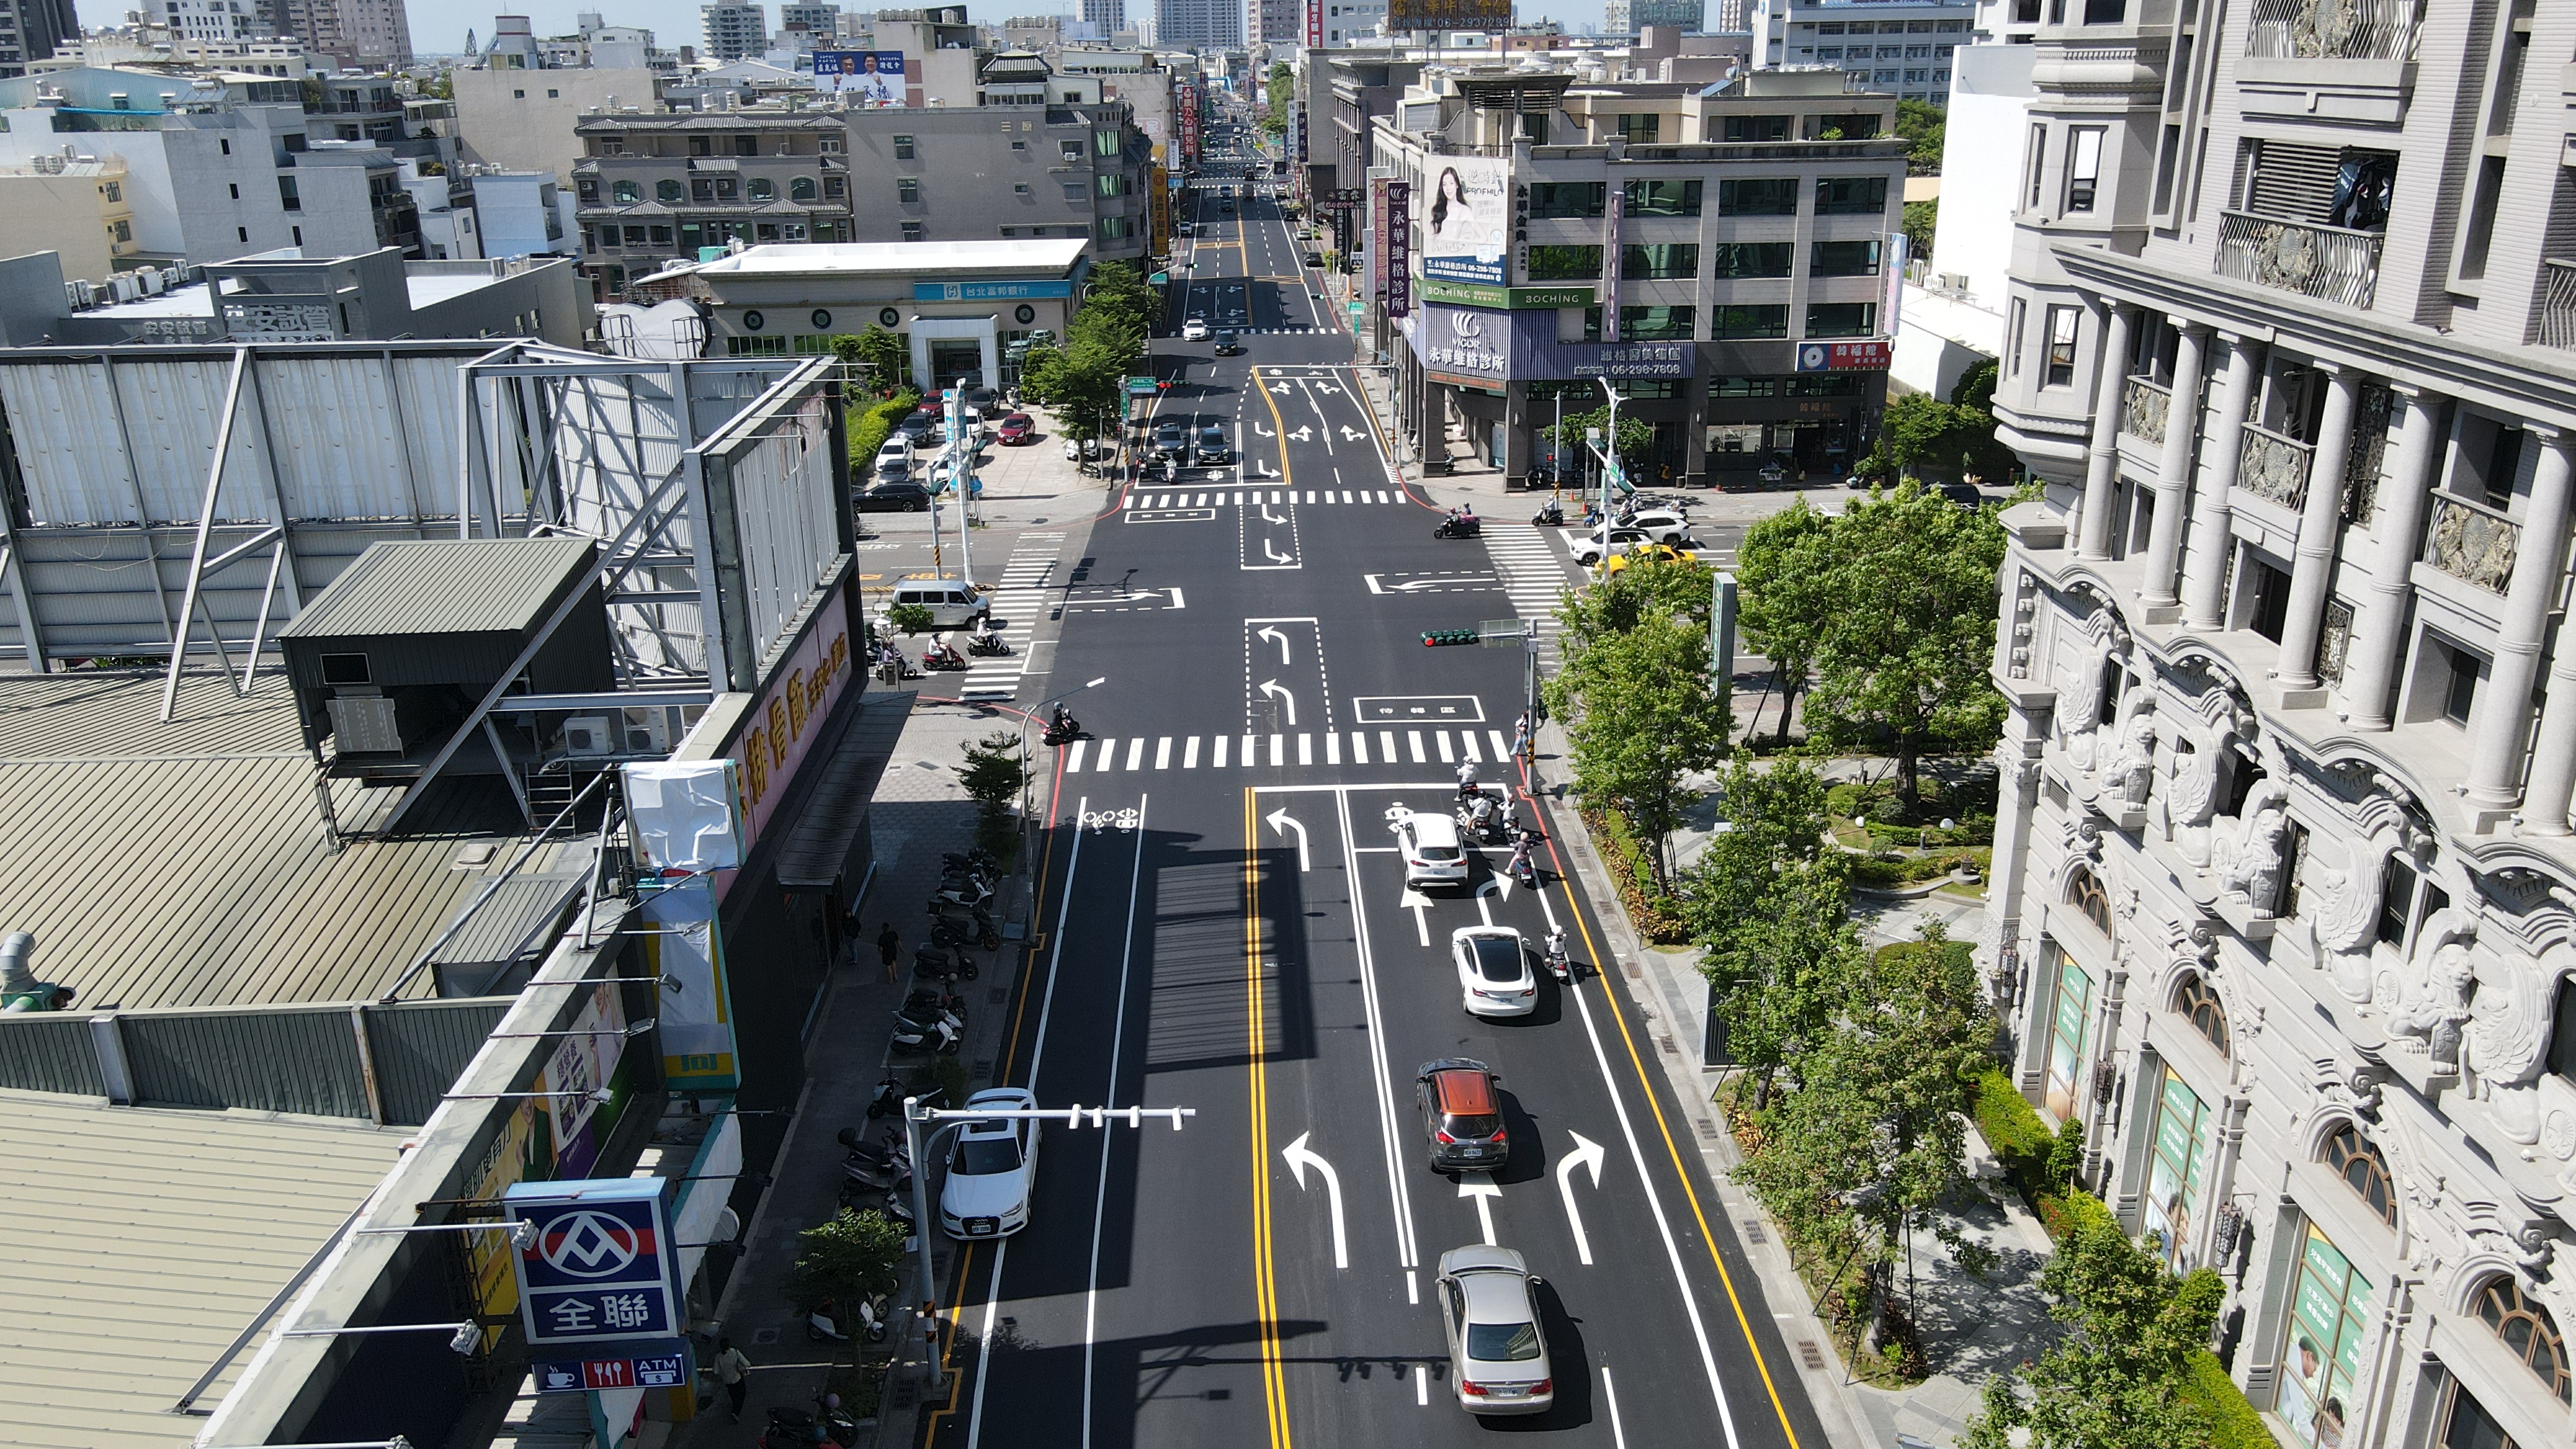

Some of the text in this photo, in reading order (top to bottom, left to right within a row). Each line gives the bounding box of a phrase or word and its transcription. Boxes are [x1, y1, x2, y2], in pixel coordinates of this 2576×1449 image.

[1390, 210, 1405, 311] 永華維格診所
[967, 286, 1028, 296] 台北富邦銀行
[1526, 293, 1579, 303] BOCHING
[223, 305, 331, 332] 安安試管
[144, 321, 207, 335] 安安試管
[1428, 346, 1505, 372] 永華維格診所
[1611, 364, 1680, 375] 06-298-7808
[549, 1293, 649, 1331] 全聯
[638, 1359, 677, 1371] ATM
